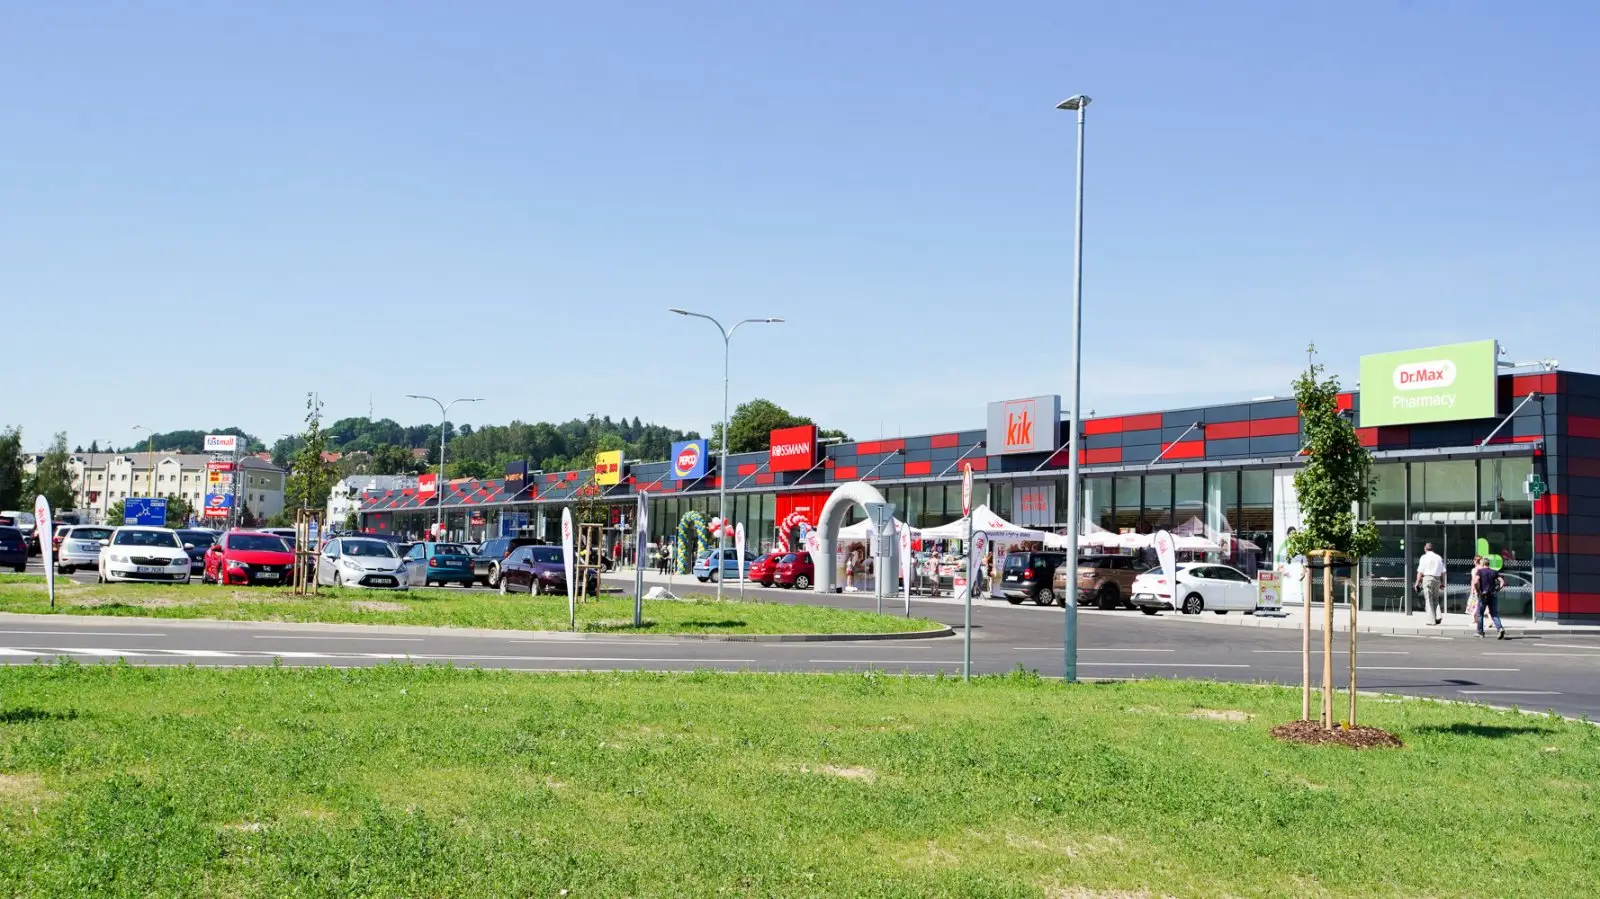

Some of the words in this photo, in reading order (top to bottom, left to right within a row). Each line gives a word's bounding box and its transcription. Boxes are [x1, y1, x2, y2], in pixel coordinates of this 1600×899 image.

[1400, 369, 1444, 384] Dr.Max
[1392, 393, 1457, 409] Pharmacy
[207, 437, 234, 446] fastmall
[771, 442, 810, 457] ROSSMANN
[678, 454, 697, 466] PEPCO
